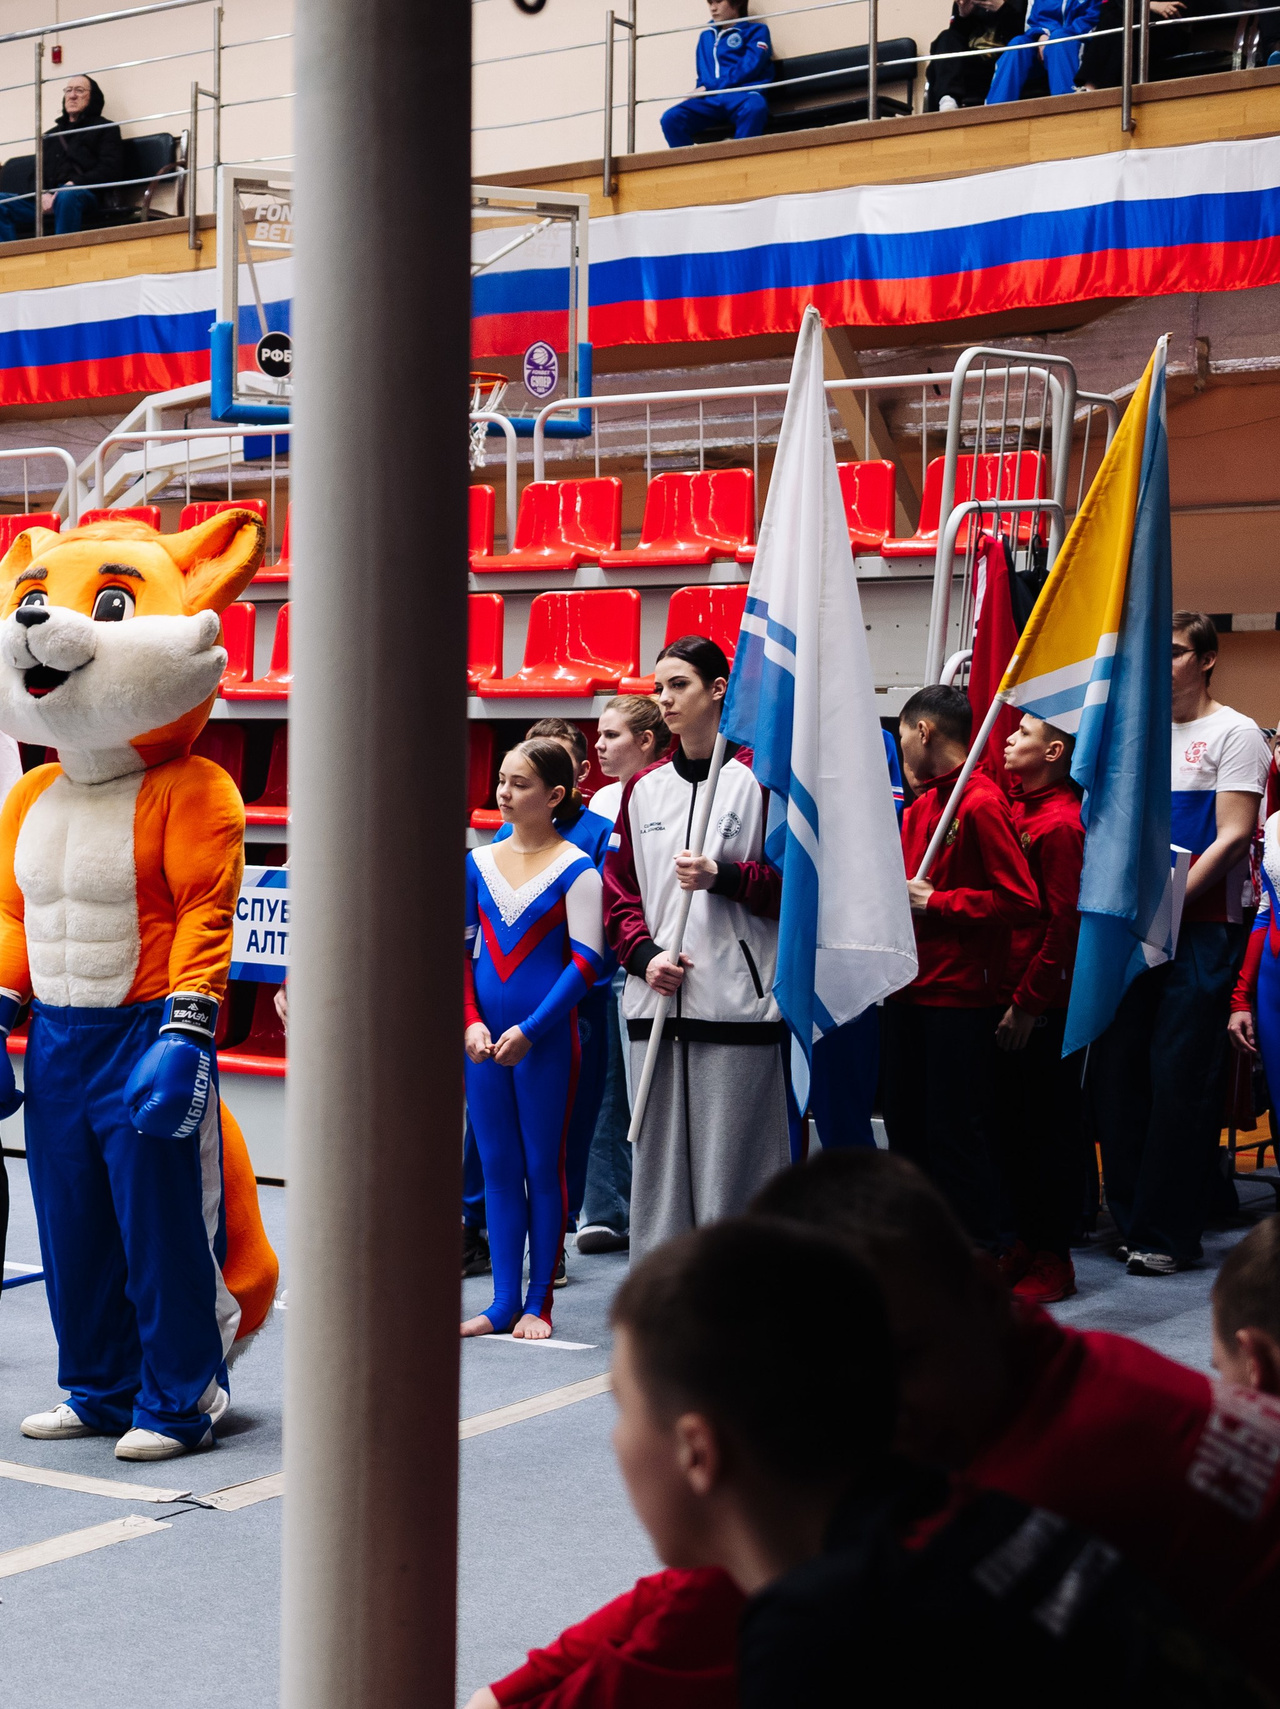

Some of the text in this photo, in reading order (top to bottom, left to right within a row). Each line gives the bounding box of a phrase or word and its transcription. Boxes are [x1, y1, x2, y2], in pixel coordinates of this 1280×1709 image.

[255, 222, 295, 241] BET
[261, 348, 292, 363] РФБ
[236, 897, 292, 923] СПУБ
[246, 929, 290, 955] АЛТ
[172, 1051, 211, 1138] КИКБОКСИНГ
